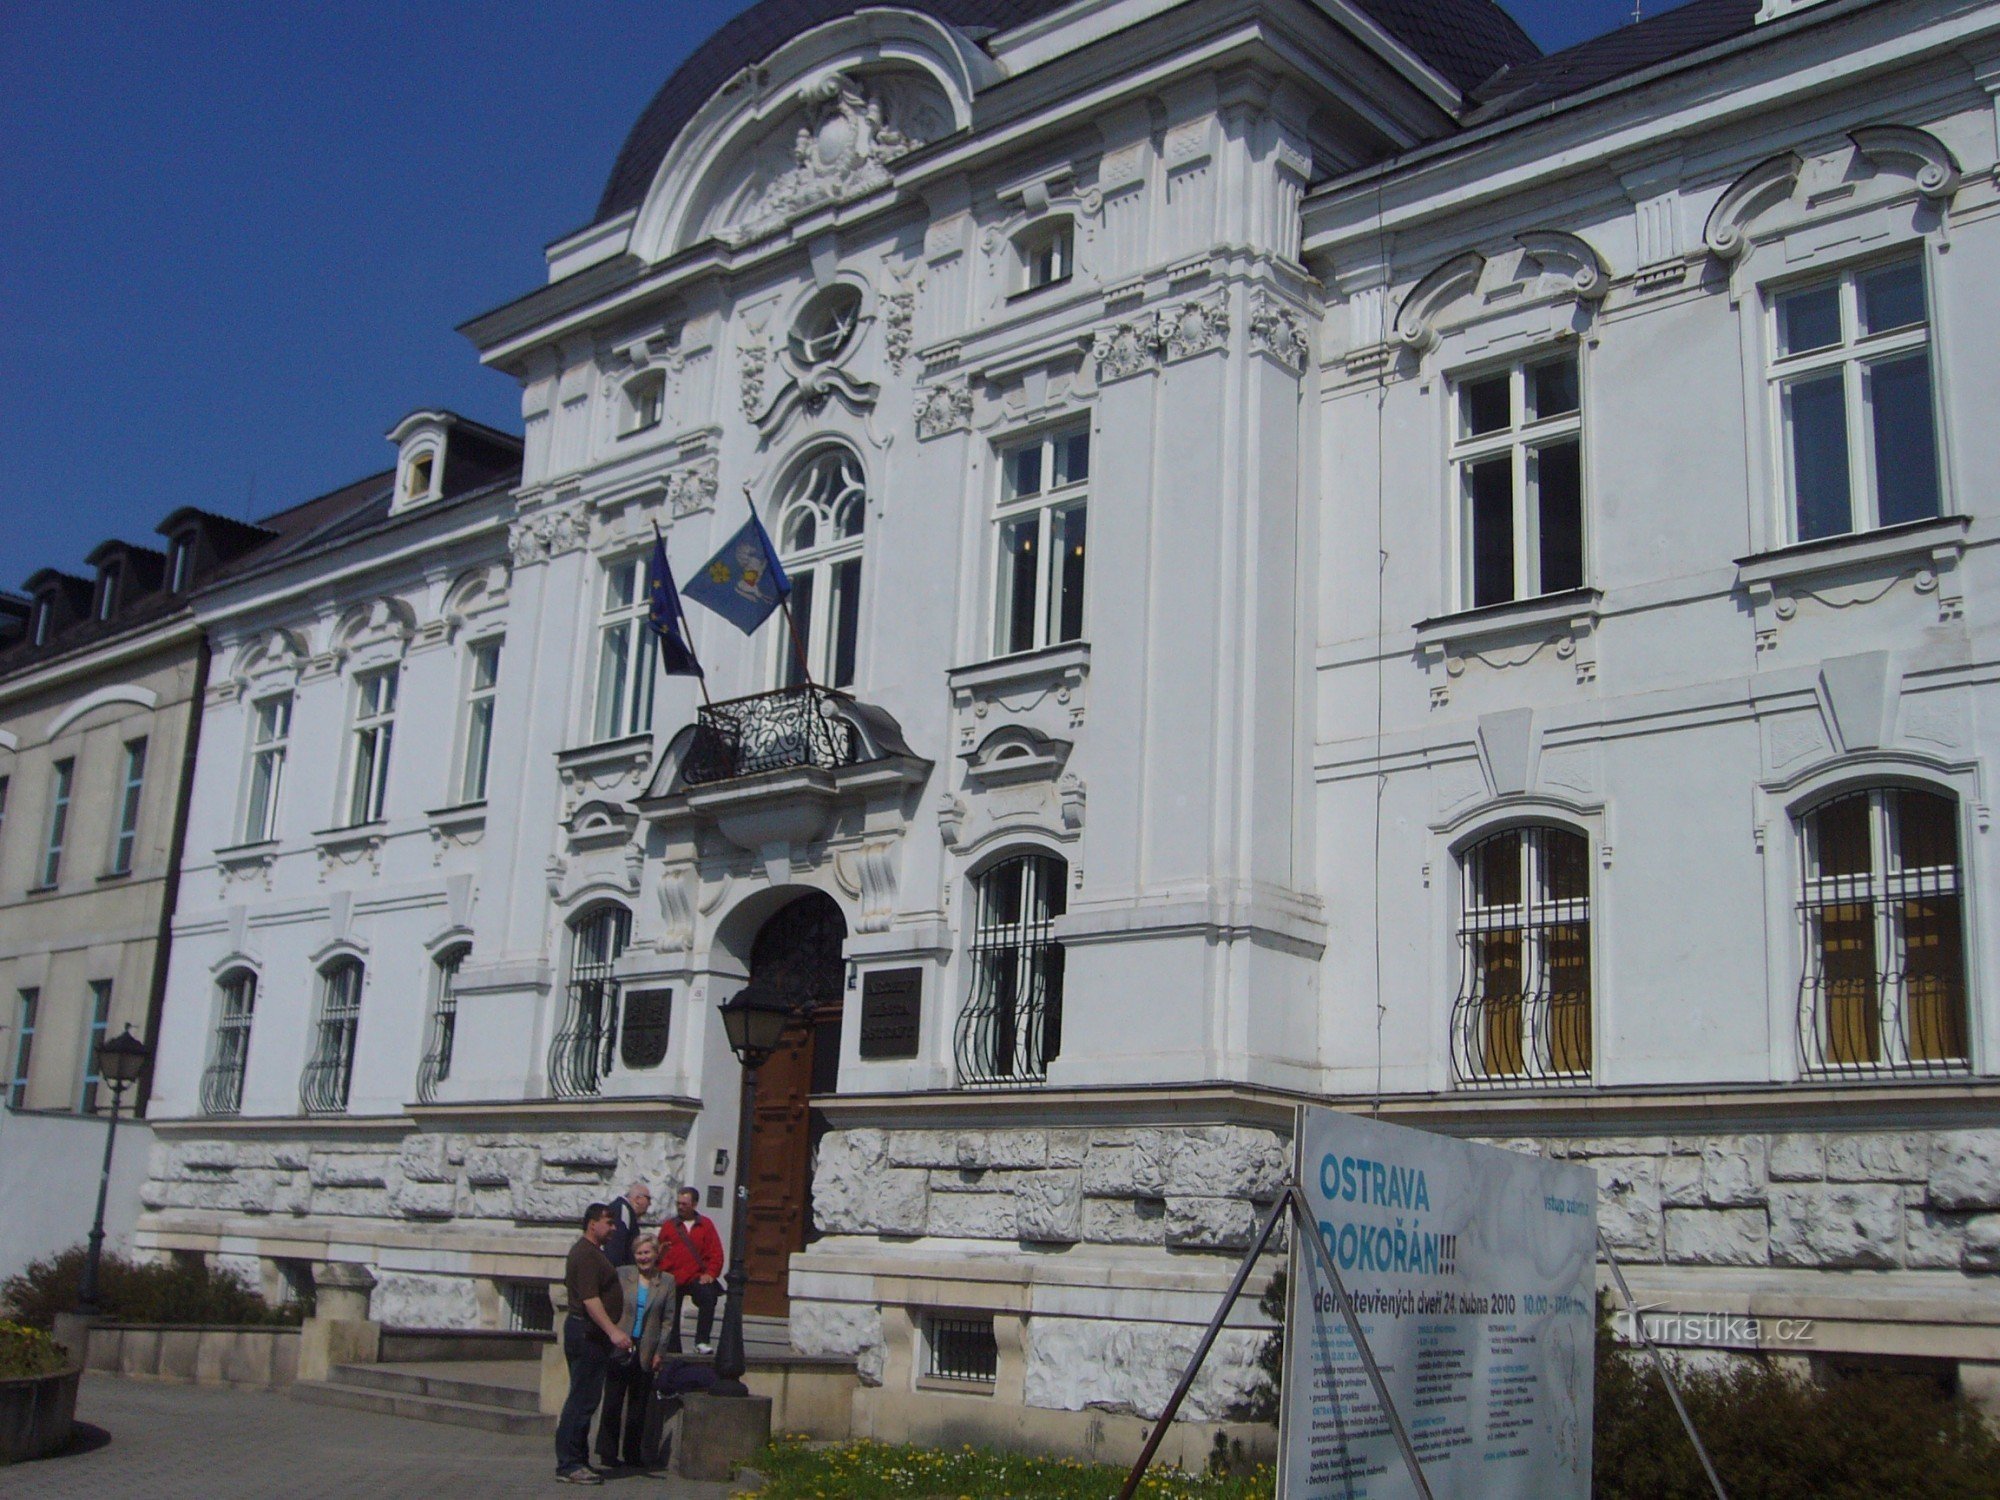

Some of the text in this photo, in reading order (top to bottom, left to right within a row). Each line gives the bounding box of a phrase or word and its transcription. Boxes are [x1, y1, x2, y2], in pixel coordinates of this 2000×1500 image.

[1320, 1153, 1430, 1212] OSTRAVA
[1417, 1290, 1443, 1315] dveří
[1460, 1292, 1489, 1315] dubna
[1491, 1292, 1516, 1315] 2010
[1523, 1294, 1547, 1316] 10.00
